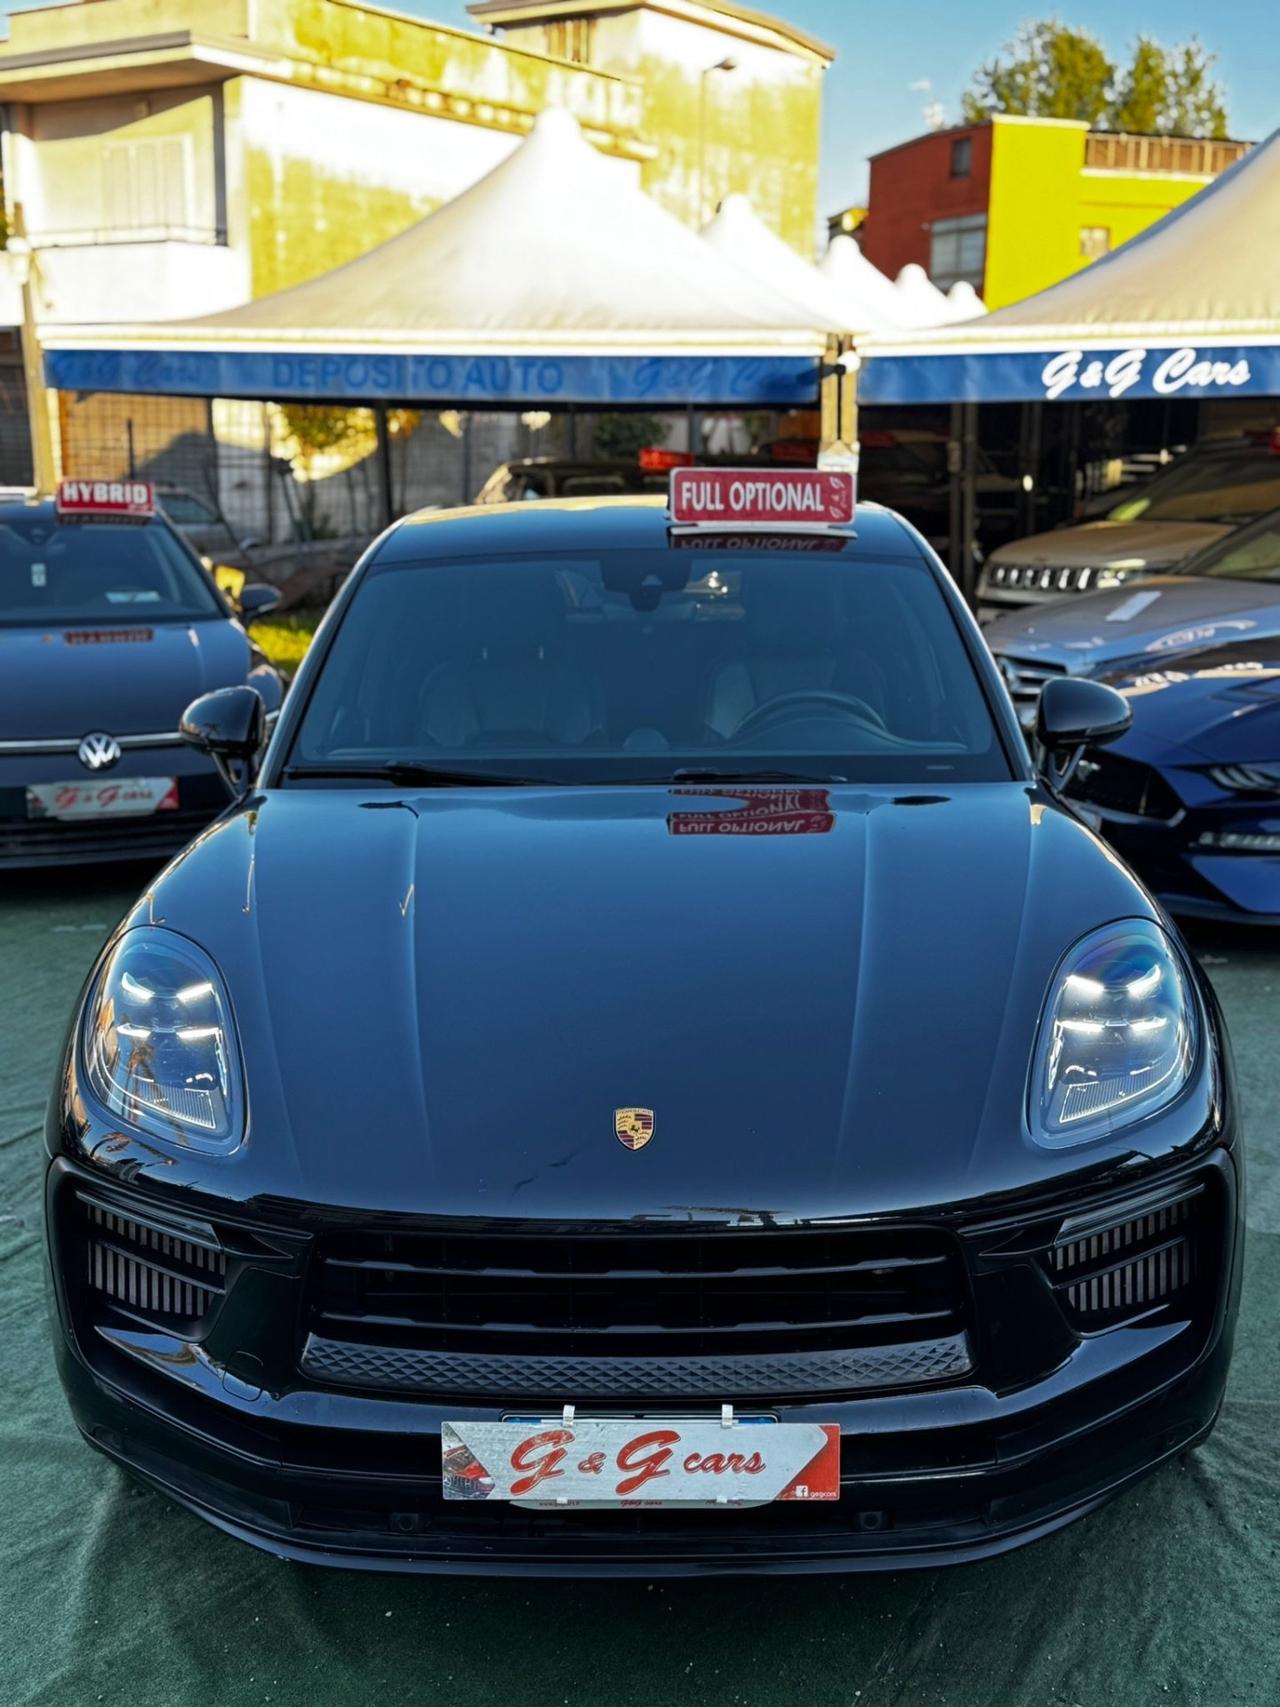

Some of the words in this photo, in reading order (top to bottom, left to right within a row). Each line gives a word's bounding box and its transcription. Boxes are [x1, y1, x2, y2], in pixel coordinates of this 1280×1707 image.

[272, 357, 451, 389] DEPOSITO
[464, 360, 564, 393] AUTO
[1041, 349, 1147, 399] G&G
[1152, 348, 1251, 393] Cars
[63, 482, 148, 504] HYBRID
[681, 481, 724, 511] FULL
[729, 481, 825, 512] OPTIONAL
[510, 1429, 575, 1495] G
[578, 1452, 607, 1475] &
[615, 1430, 681, 1495] G
[683, 1452, 766, 1475] cars
